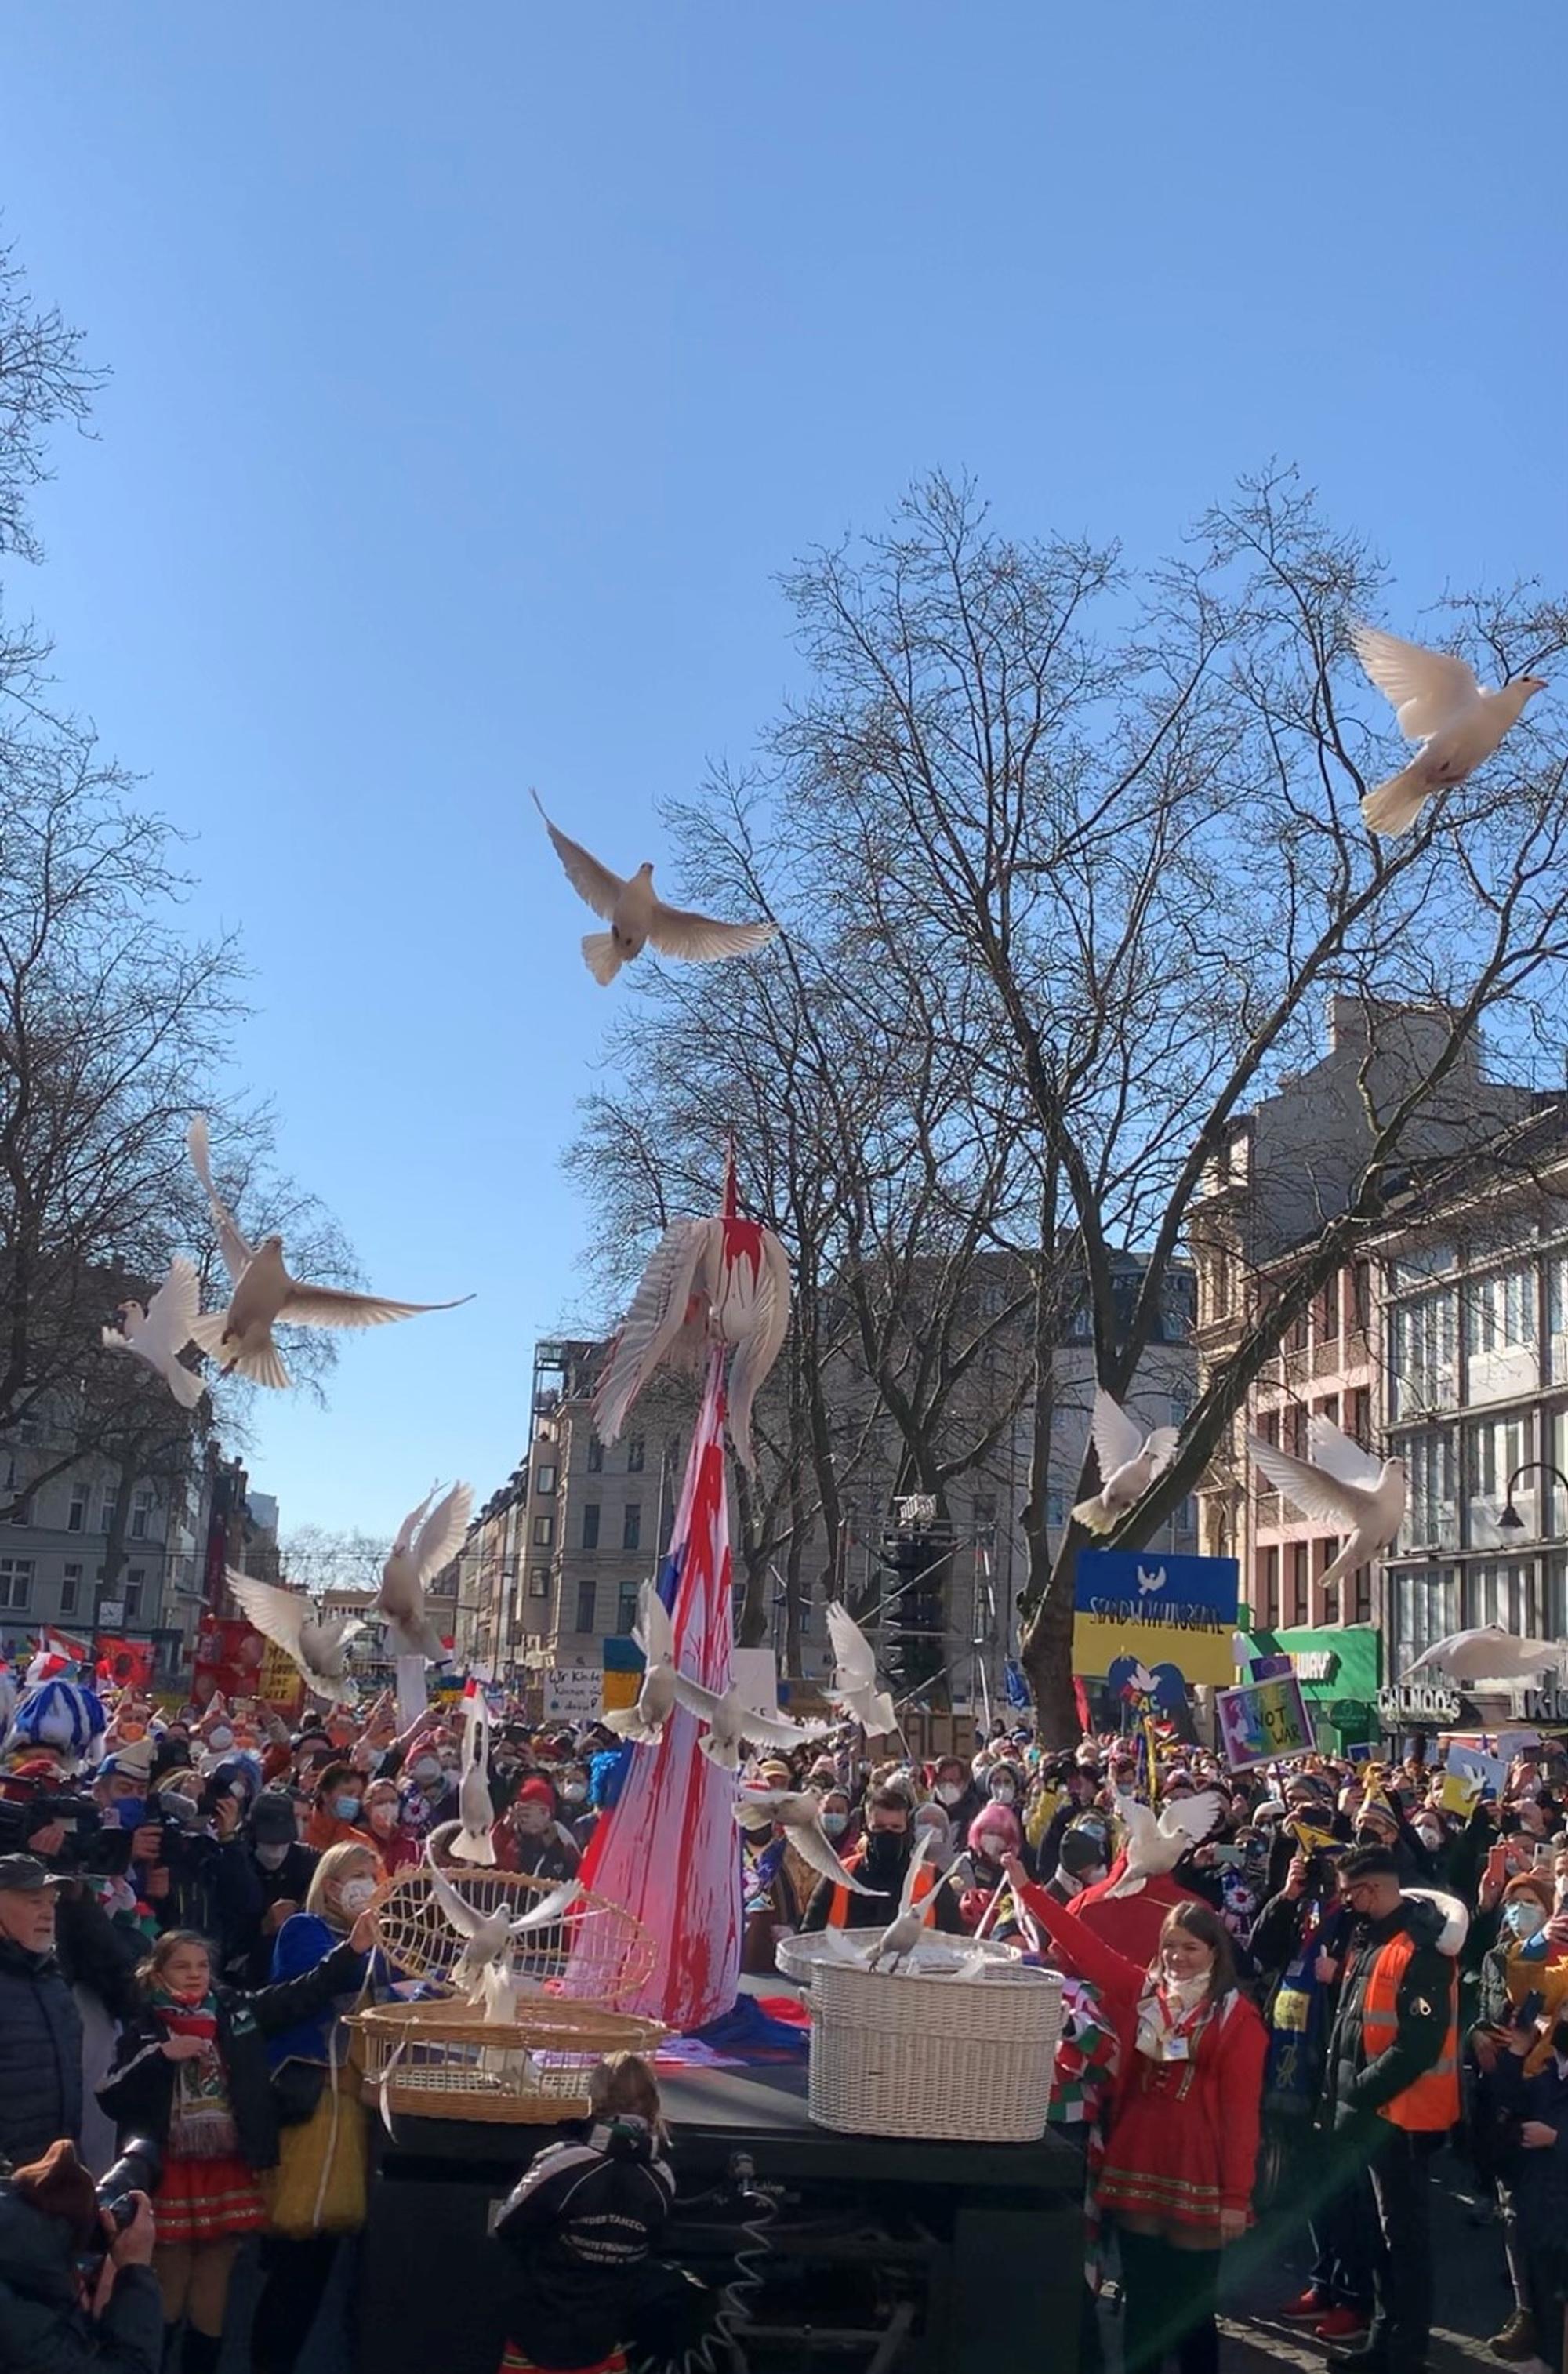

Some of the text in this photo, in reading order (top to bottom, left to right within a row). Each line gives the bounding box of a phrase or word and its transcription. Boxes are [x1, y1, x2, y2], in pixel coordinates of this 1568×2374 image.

[1275, 1650, 1331, 1679] WAY
[1252, 1705, 1287, 1730] NOT
[1272, 1724, 1301, 1745] WAR
